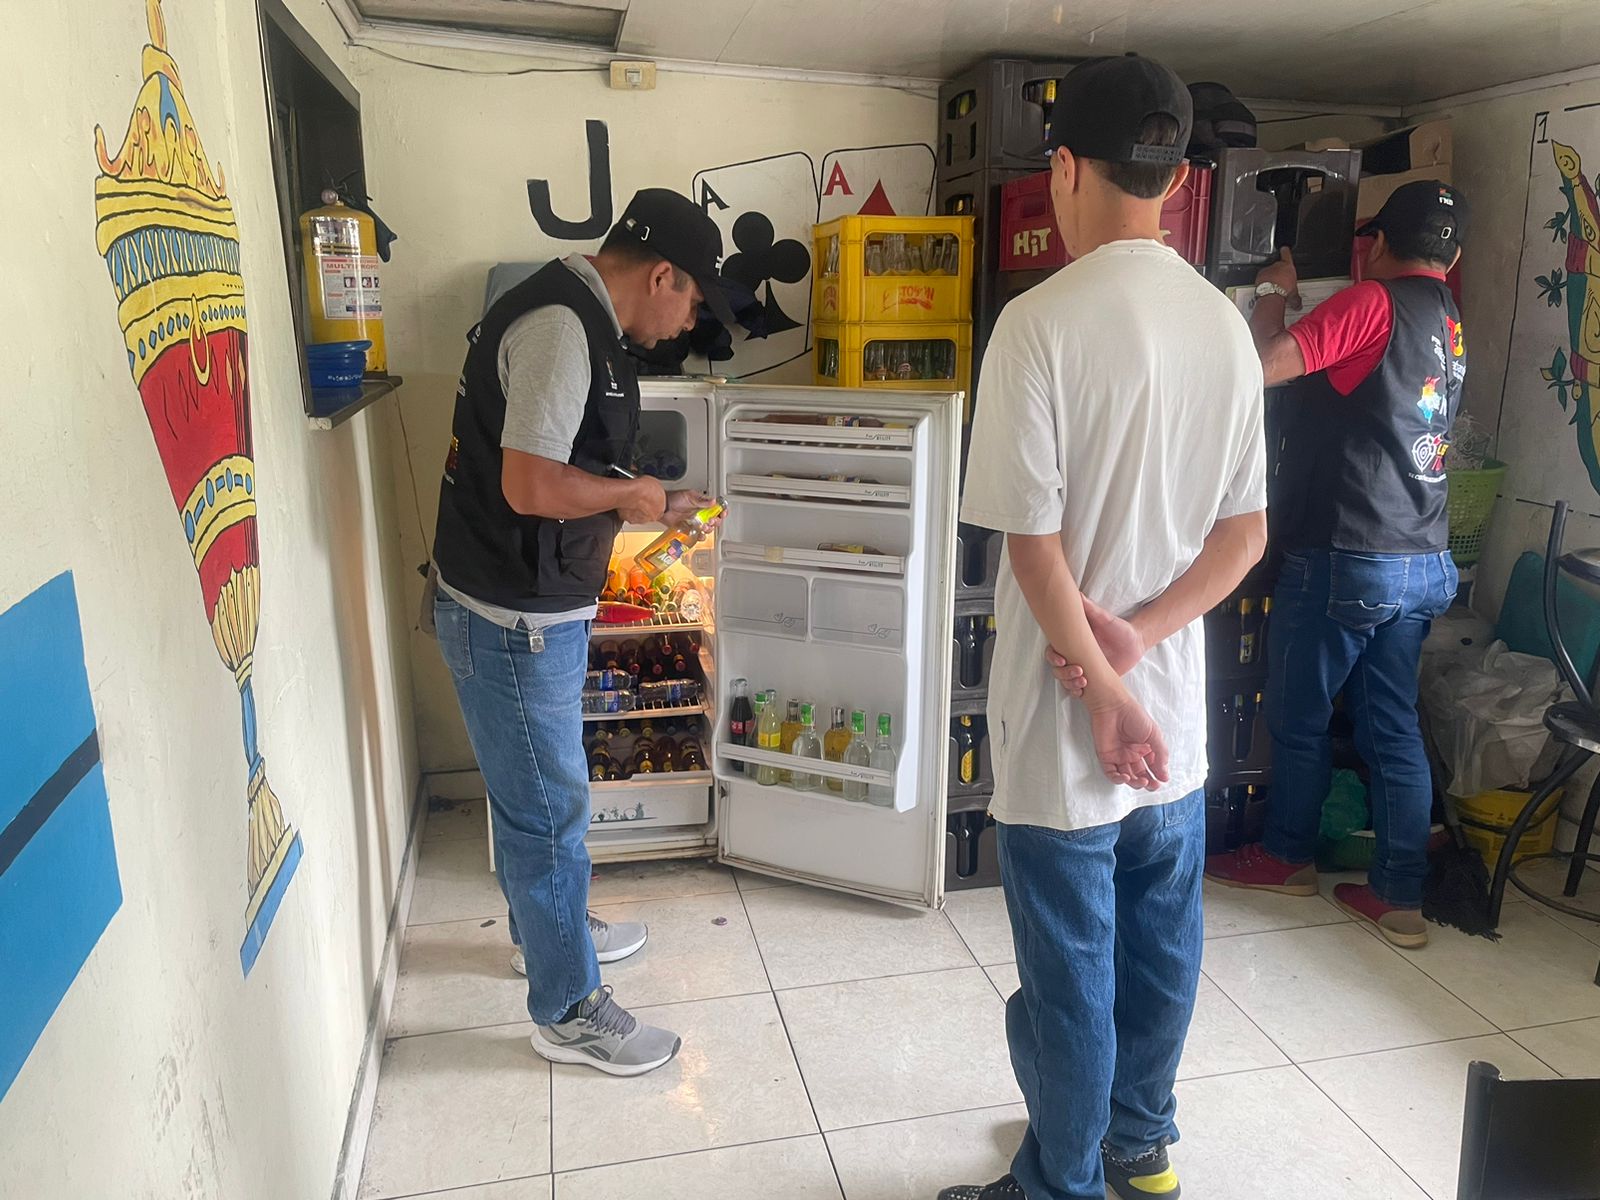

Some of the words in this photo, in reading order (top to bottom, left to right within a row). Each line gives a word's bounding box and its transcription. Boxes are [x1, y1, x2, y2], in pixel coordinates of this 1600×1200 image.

[526, 119, 613, 240] J
[701, 178, 730, 217] A
[822, 160, 854, 196] A
